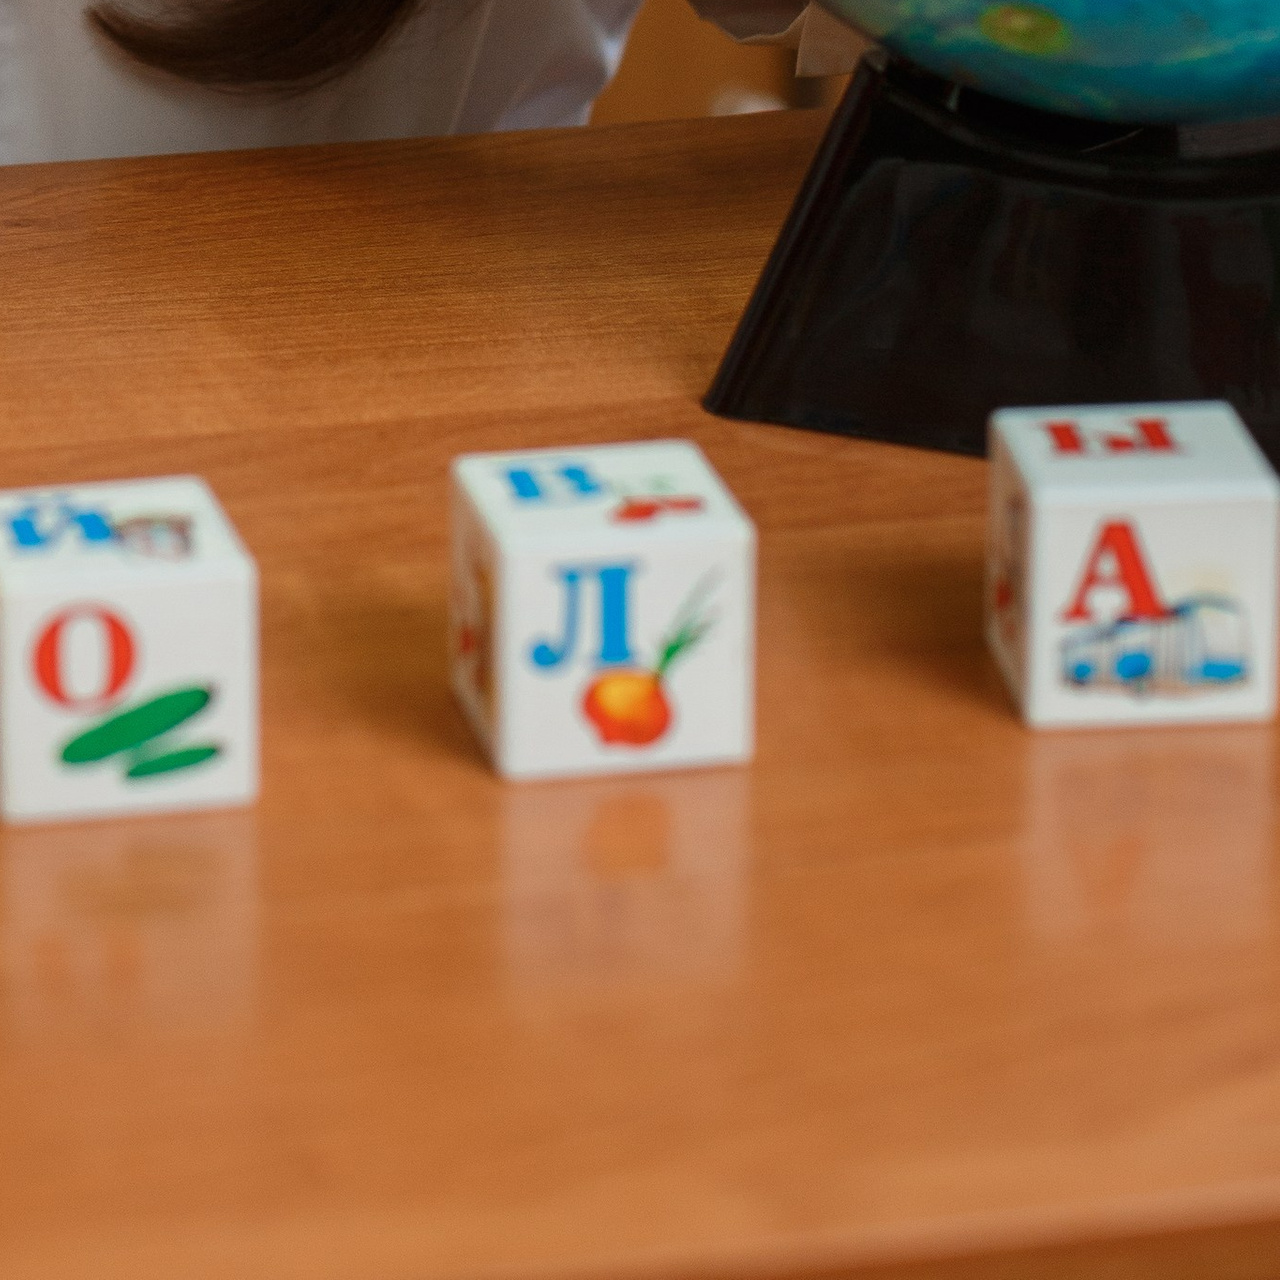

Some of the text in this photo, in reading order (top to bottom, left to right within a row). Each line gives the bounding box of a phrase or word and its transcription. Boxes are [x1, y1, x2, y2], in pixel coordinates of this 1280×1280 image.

[528, 558, 642, 672] Л
[1058, 514, 1182, 624] А
[28, 600, 140, 715] О
